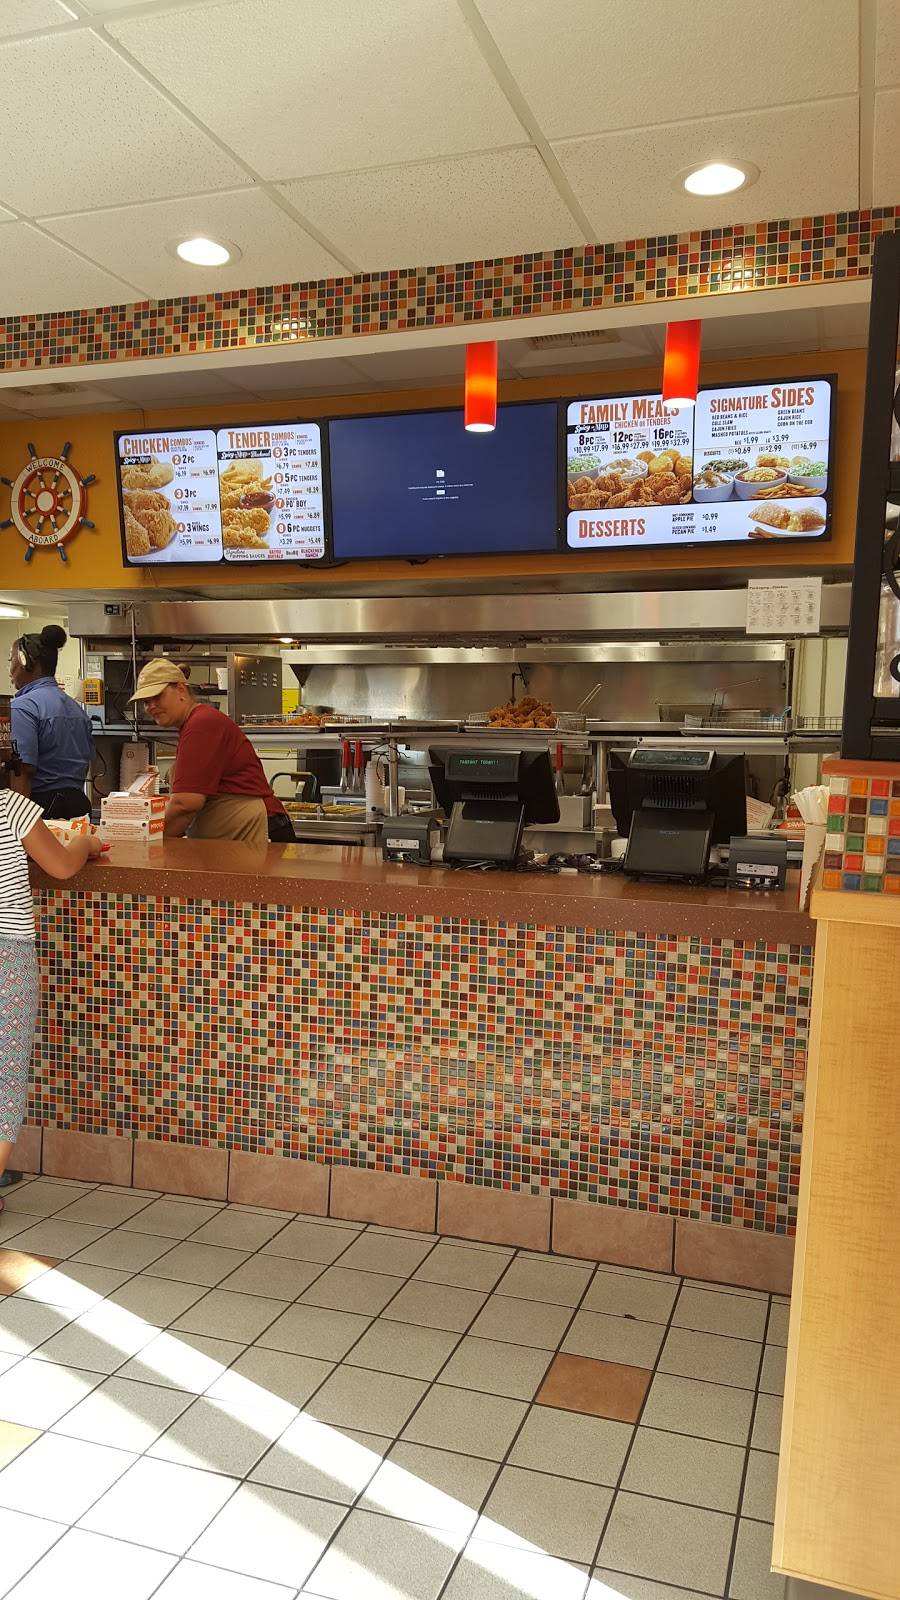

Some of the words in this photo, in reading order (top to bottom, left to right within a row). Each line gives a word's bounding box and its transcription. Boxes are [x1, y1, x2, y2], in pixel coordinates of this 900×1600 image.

[710, 395, 768, 413] SIGNATURE
[771, 386, 814, 408] SIDES
[580, 402, 628, 423] FAMILY
[614, 420, 638, 429] CHICKEN
[646, 418, 671, 426] TENDERS
[228, 431, 270, 448] TENDER
[652, 440, 669, 448] $19.99
[670, 438, 689, 447] $32.99
[743, 436, 758, 444] $1.99
[772, 434, 789, 442] $3.99
[123, 437, 170, 455] CHICKEN
[591, 444, 608, 452] $17.99
[612, 443, 629, 451] $16.99
[630, 441, 649, 450] $27.99
[734, 446, 750, 454] $0.69
[765, 444, 782, 452] $2.99
[800, 442, 817, 450] $6.99
[297, 448, 317, 456] TENDERS
[25, 460, 64, 472] WELCOME
[191, 524, 210, 532] WINGS
[578, 518, 645, 538] DESSERTS
[702, 525, 716, 533] $1.49
[28, 534, 58, 544] ABOARD
